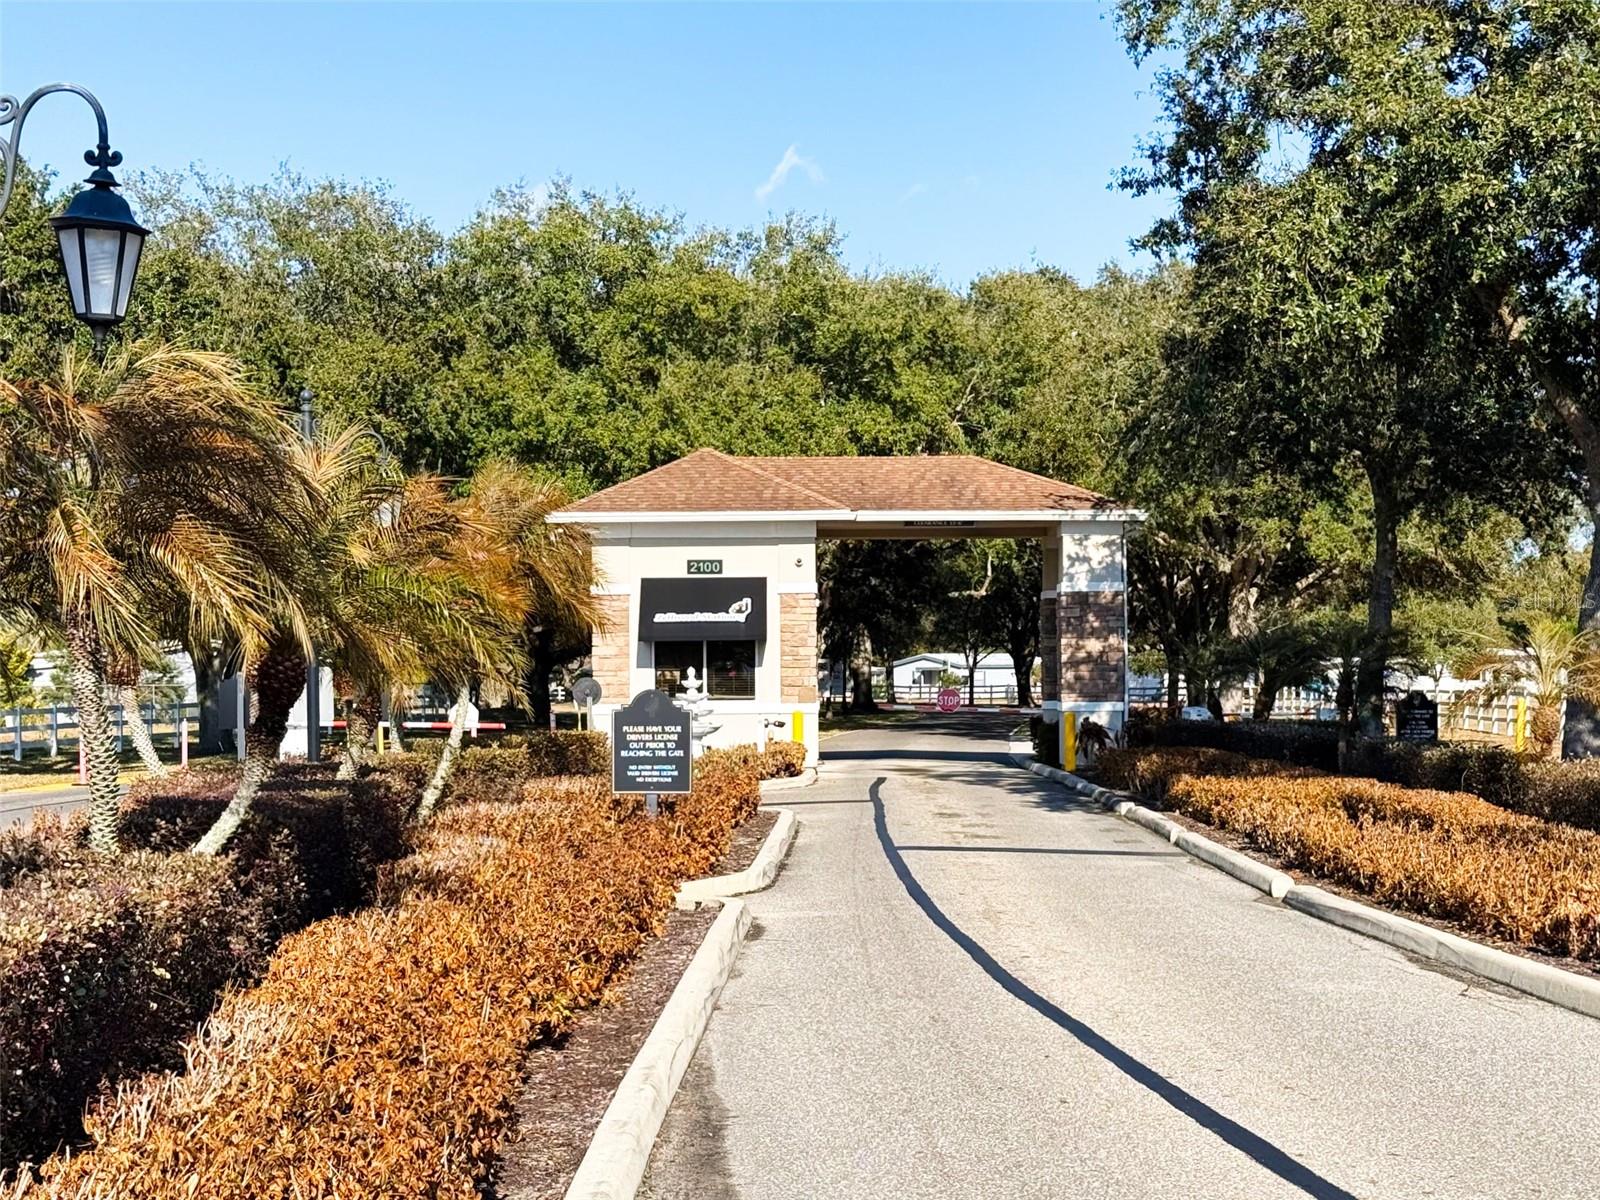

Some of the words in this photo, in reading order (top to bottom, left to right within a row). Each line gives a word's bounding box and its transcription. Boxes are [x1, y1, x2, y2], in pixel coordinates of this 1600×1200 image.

[689, 562, 720, 573] 2100
[938, 696, 960, 705] STOP
[622, 725, 645, 733] PLEASE
[646, 725, 662, 733] HAVE
[663, 725, 682, 733] YOUR
[626, 733, 653, 741] DRIVERS
[654, 733, 679, 741] LICENSE
